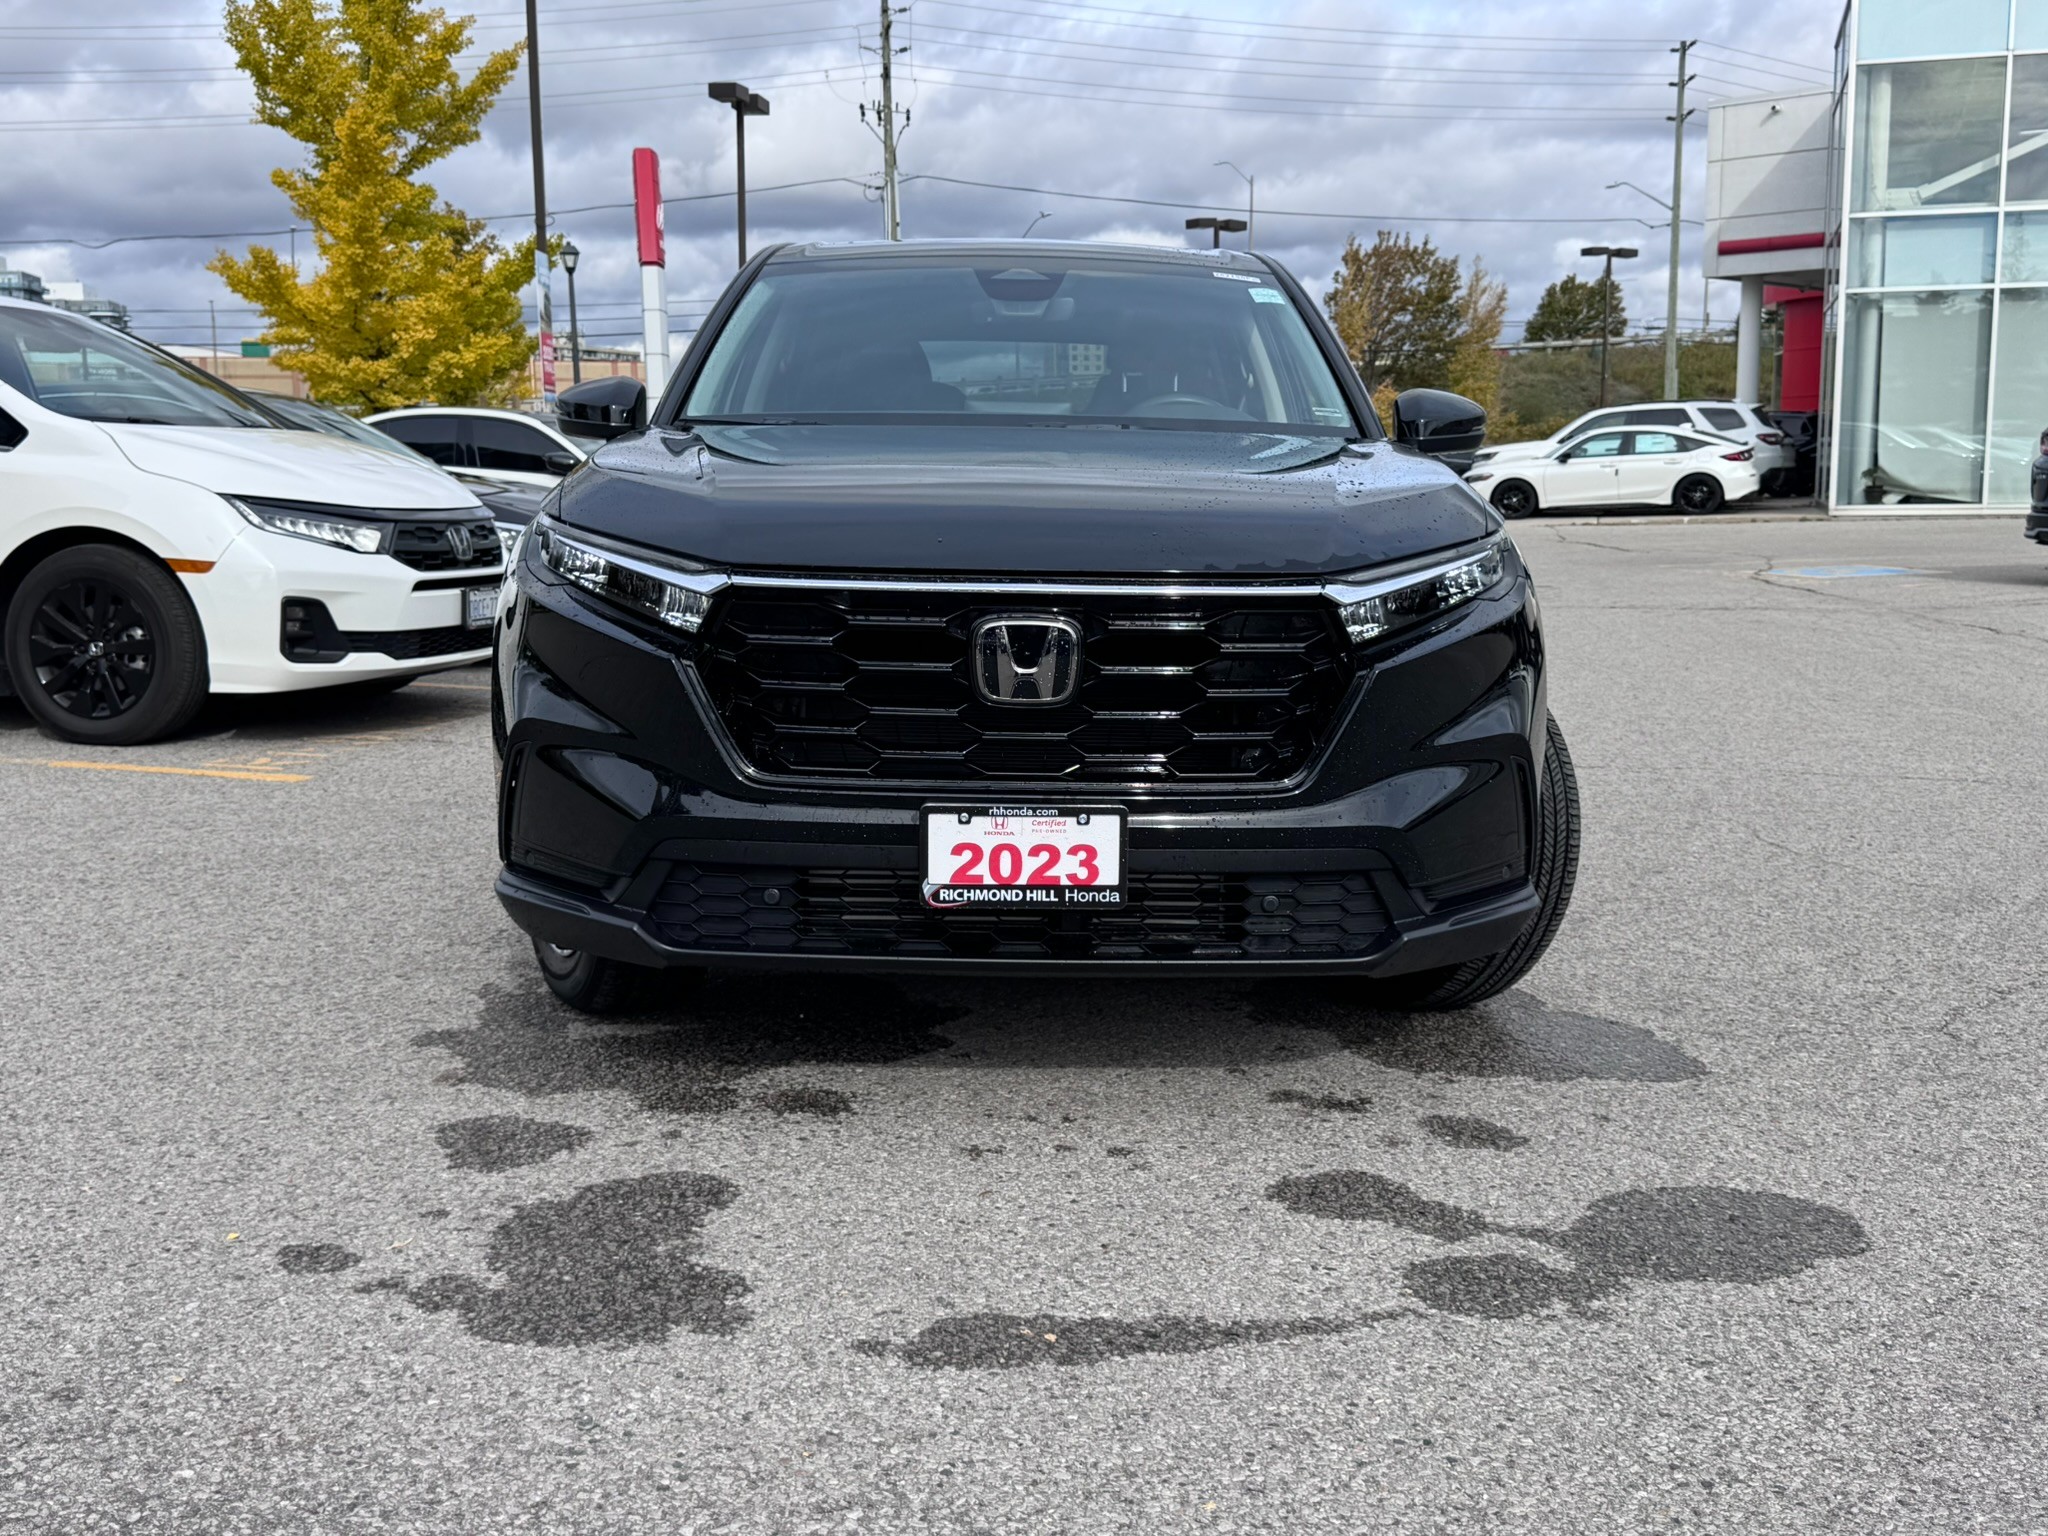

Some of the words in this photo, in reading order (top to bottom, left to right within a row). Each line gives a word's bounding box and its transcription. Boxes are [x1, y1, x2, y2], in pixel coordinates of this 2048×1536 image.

[988, 807, 1058, 816] rhhonda.com
[1031, 819, 1067, 828] Certified
[949, 842, 1100, 886] 2023
[939, 888, 1024, 902] RICHMOND
[1026, 889, 1059, 902] HILL
[1065, 888, 1121, 903] Honda
